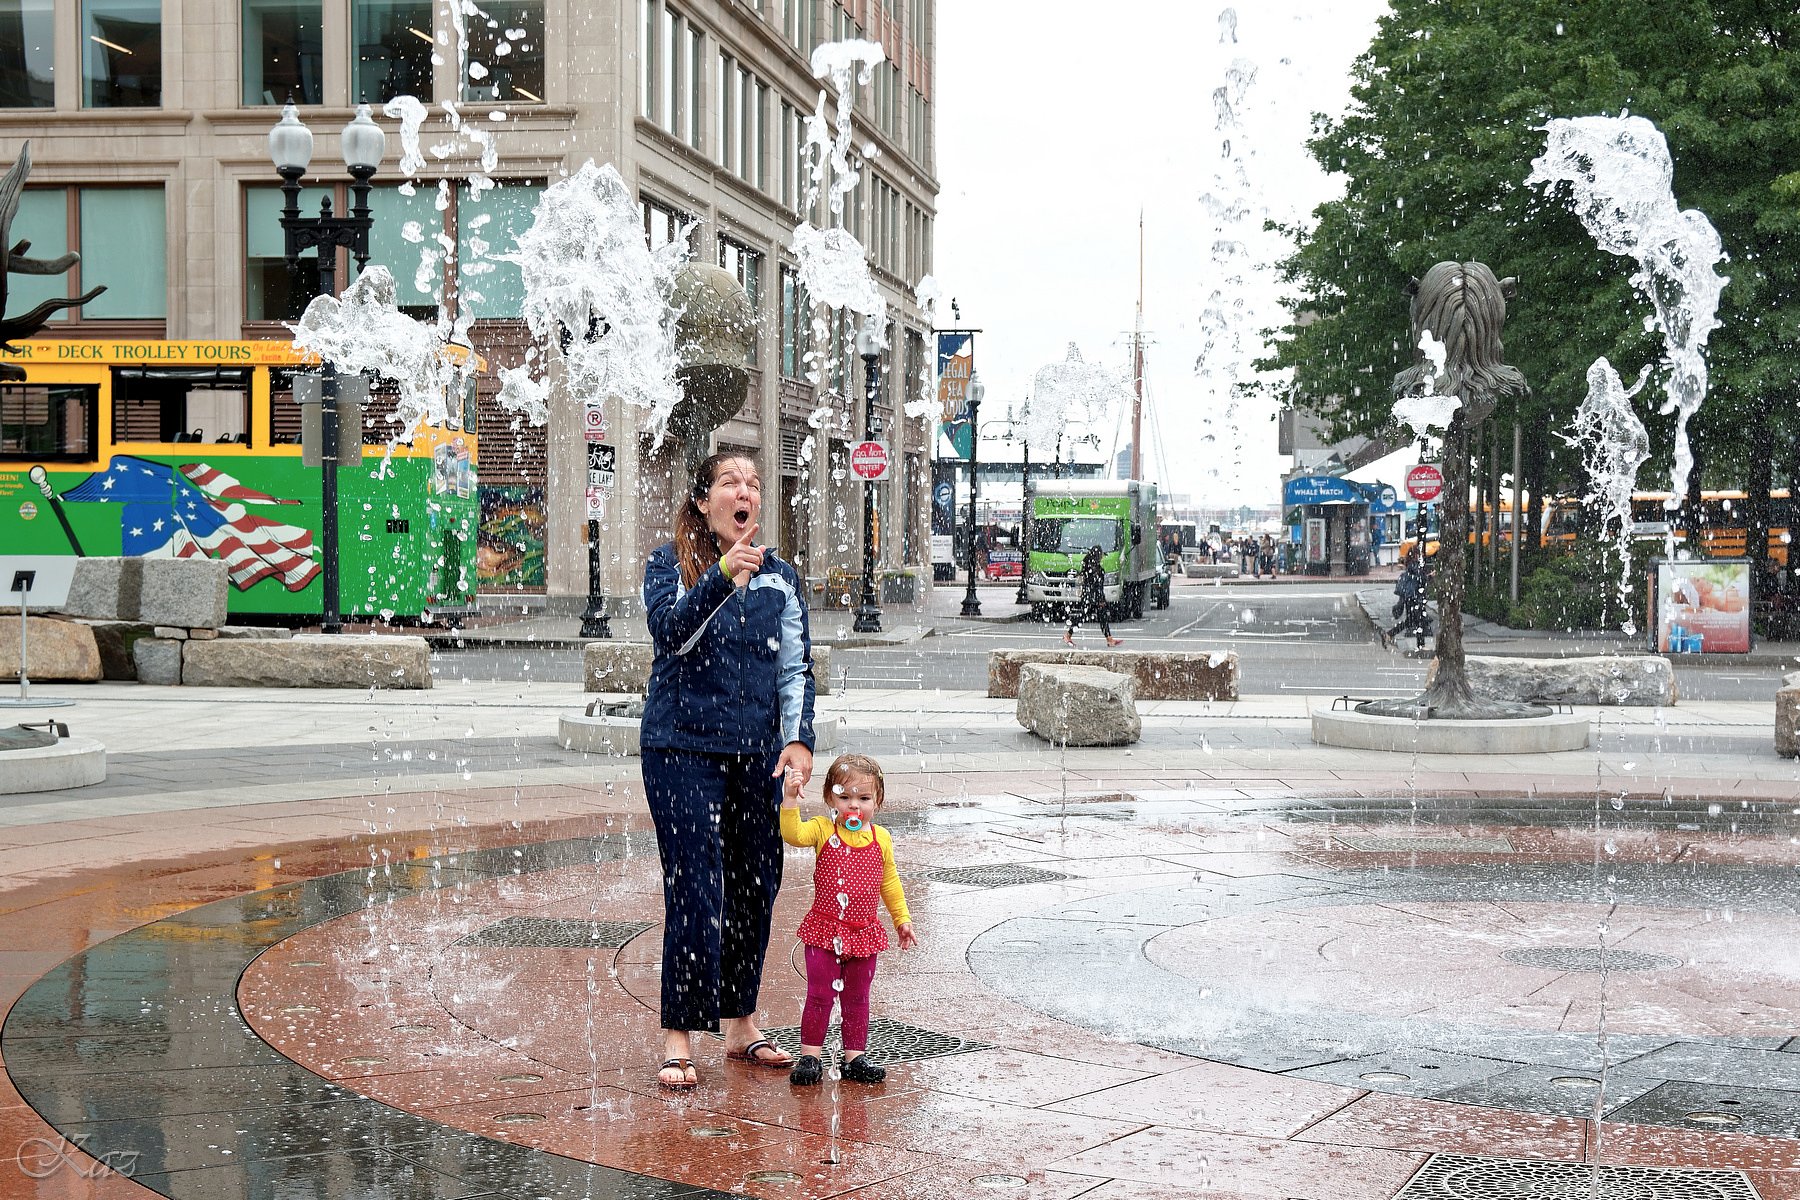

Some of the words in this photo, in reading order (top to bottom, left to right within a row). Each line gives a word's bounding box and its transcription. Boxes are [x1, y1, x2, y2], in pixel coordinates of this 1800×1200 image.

[58, 345, 103, 358] DECK
[112, 345, 188, 359] TROLLEY
[193, 345, 251, 360] TOURS
[942, 361, 969, 379] LEGAL
[947, 381, 963, 397] SEA
[943, 400, 969, 415] OODS
[1294, 488, 1318, 496] WHALE
